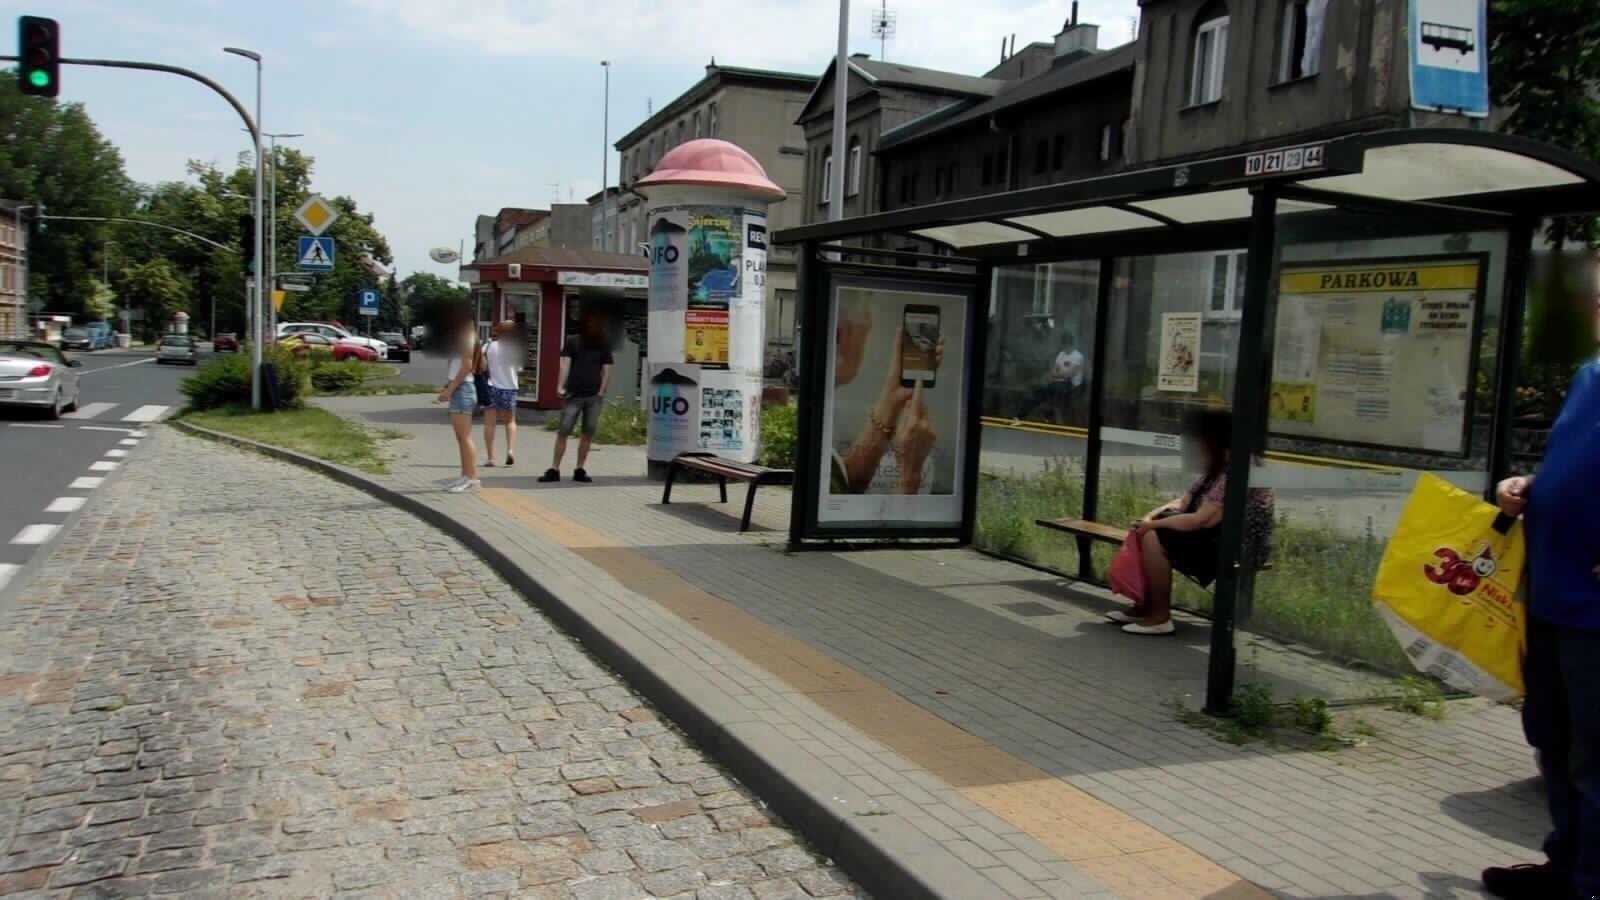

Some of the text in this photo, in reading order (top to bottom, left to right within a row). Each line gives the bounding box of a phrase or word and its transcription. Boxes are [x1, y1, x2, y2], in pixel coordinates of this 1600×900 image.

[1247, 157, 1261, 172] 10
[1266, 154, 1280, 169] 21
[1320, 271, 1418, 289] PARKOWA
[364, 291, 375, 306] P
[652, 396, 689, 416] UFO
